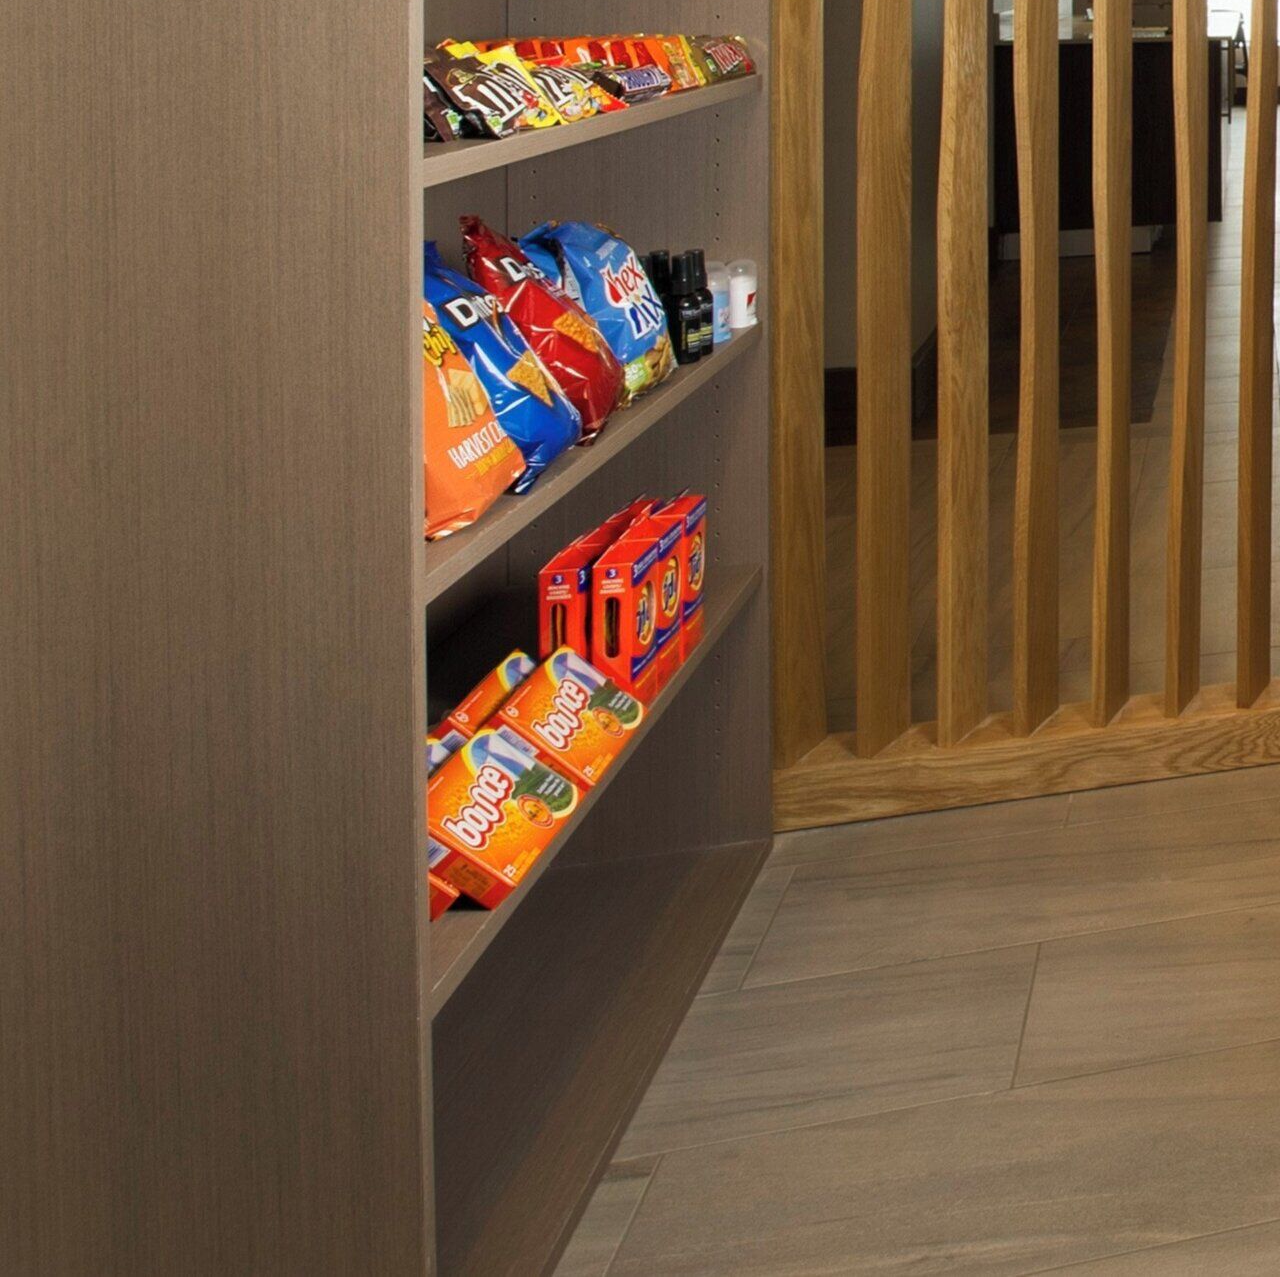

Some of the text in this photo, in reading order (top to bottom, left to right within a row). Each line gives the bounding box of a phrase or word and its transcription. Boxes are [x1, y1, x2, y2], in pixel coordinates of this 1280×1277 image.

[448, 427, 493, 470] HARVEST
[532, 679, 587, 750] bounce
[442, 765, 512, 849] bounce
